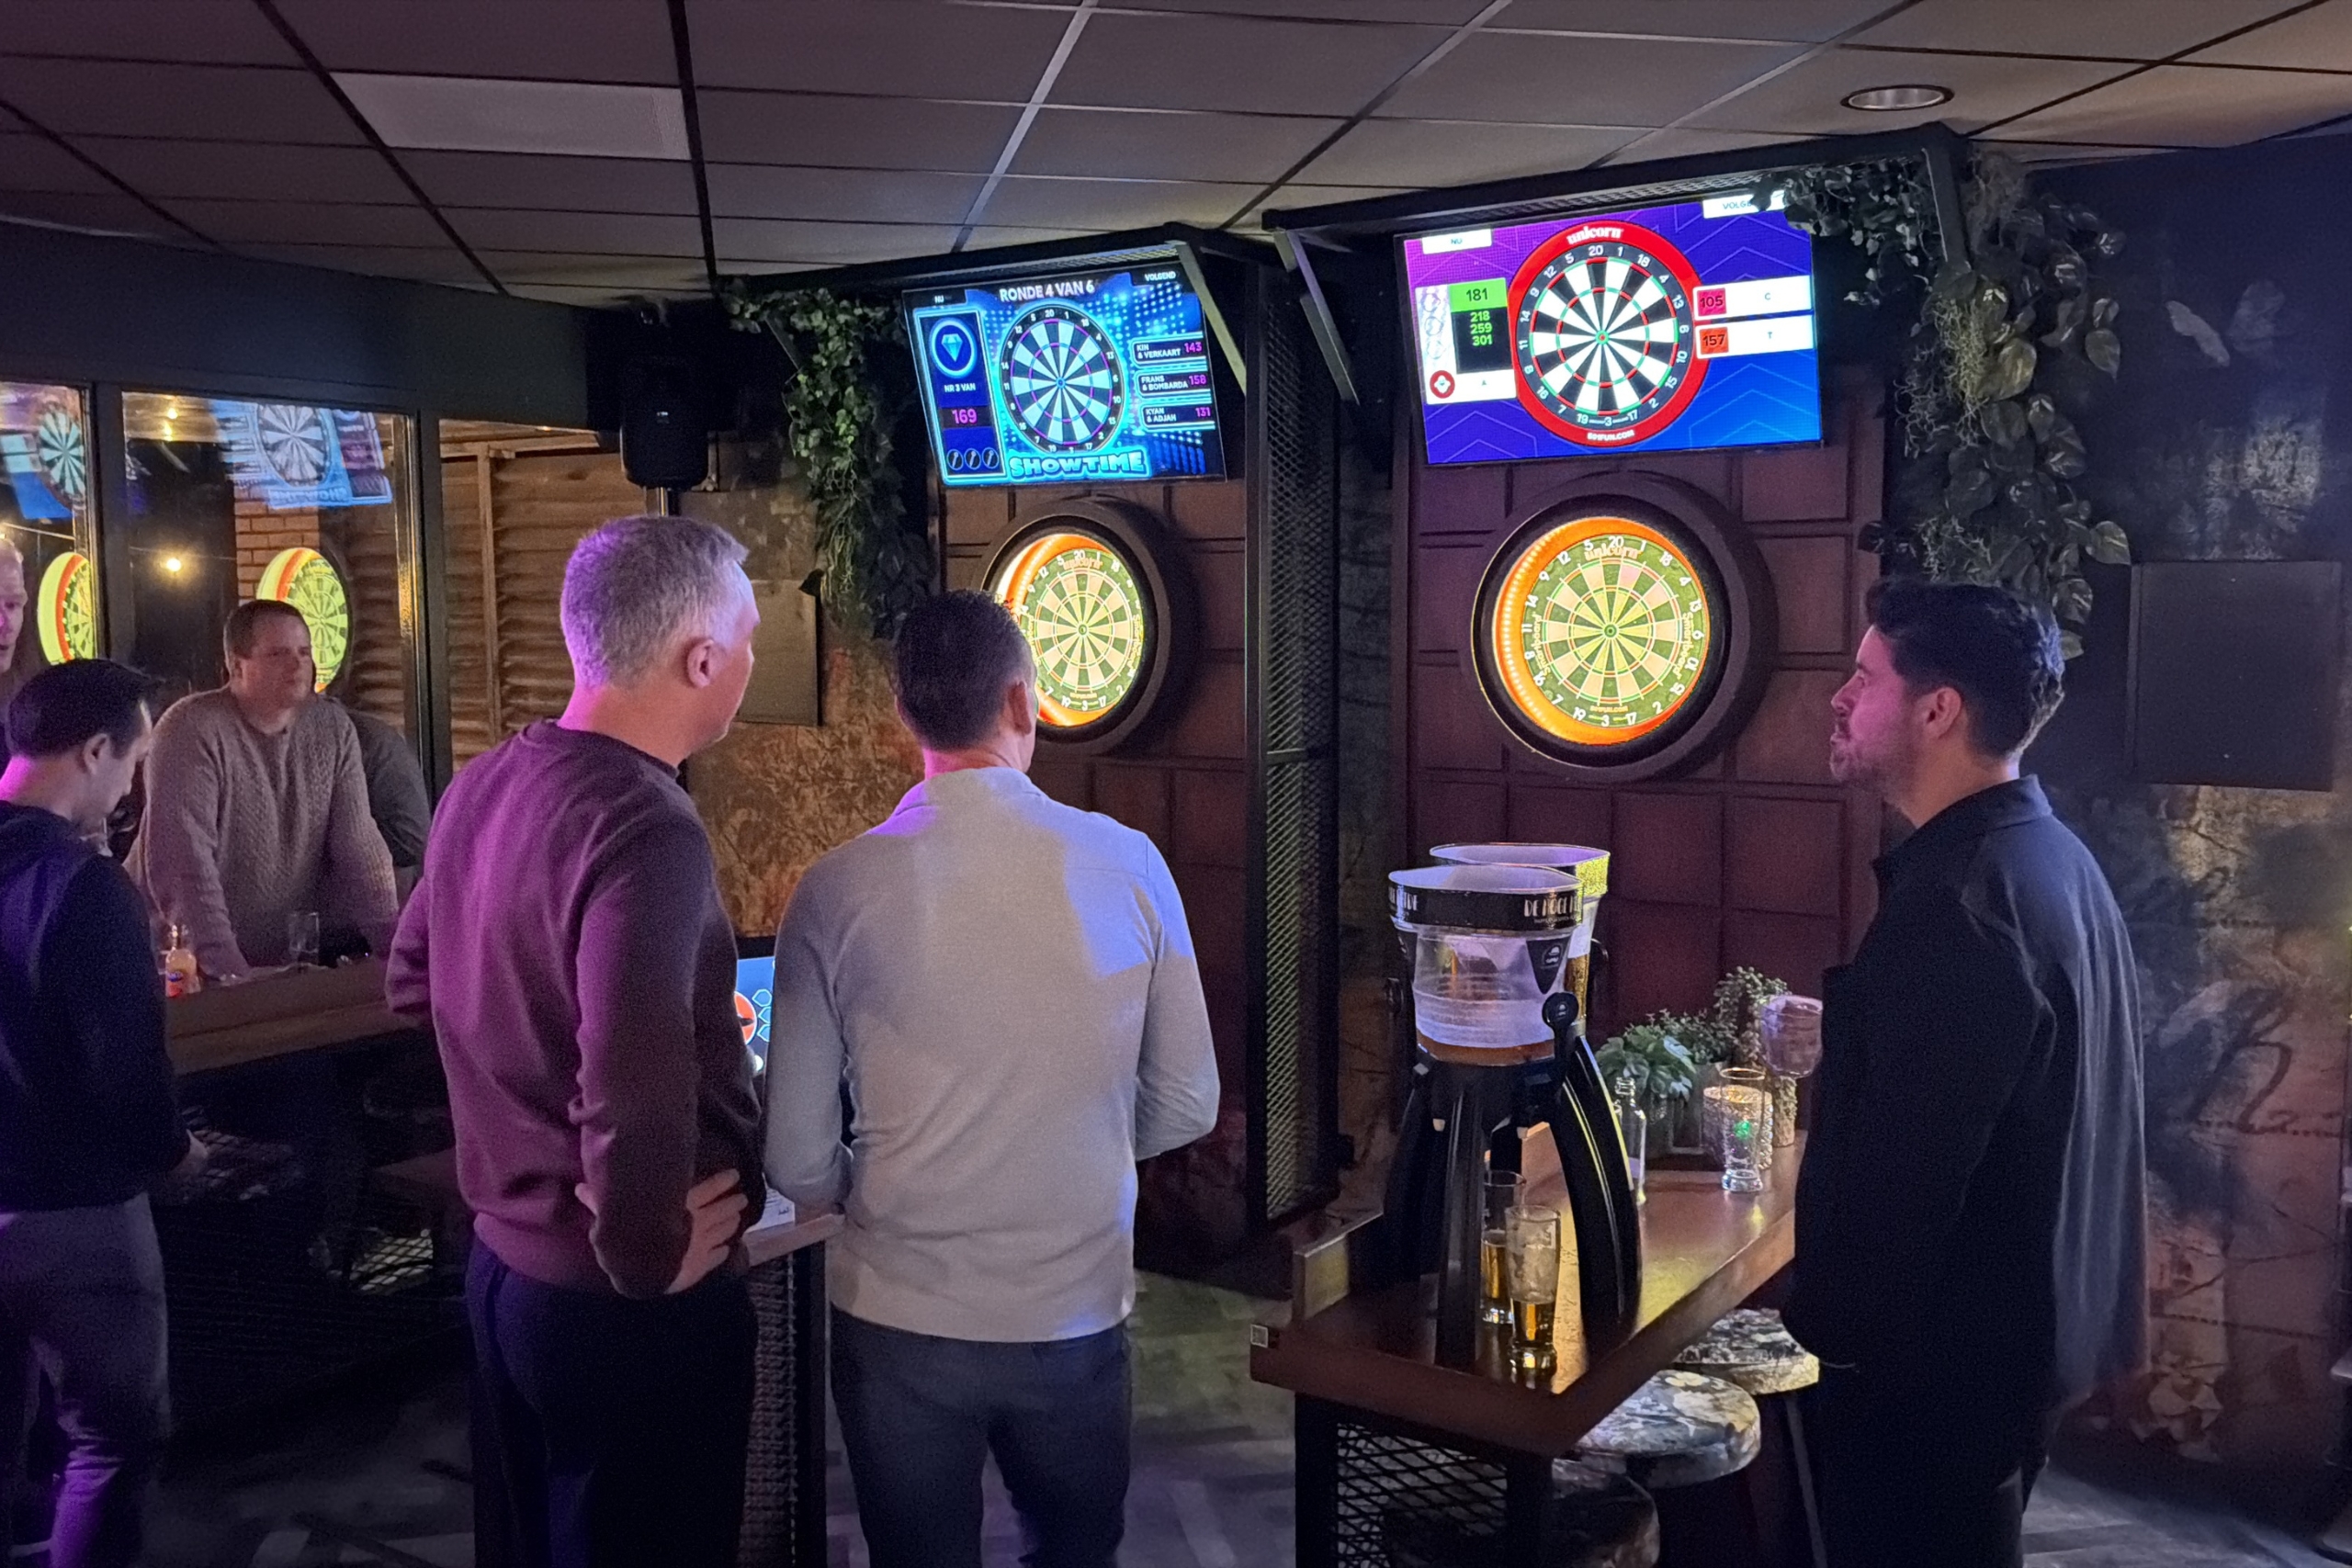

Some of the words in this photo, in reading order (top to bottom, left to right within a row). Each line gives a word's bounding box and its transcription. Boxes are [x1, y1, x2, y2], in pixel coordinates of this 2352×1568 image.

[1566, 226, 1624, 245] unicorn
[1589, 245, 1603, 256] 20
[1618, 246, 1624, 256] 1
[1565, 254, 1575, 265] 5
[1637, 254, 1650, 267] 18
[1145, 271, 1177, 281] VOLGEND
[1544, 265, 1556, 278] 12
[1659, 274, 1669, 283] 4
[999, 285, 1044, 302] RONDE
[1045, 284, 1054, 297] 4
[1055, 280, 1084, 296] VAN
[1085, 279, 1095, 293] 6
[1465, 288, 1488, 302] 181
[1530, 287, 1540, 298] 9
[934, 295, 944, 303] NU
[1673, 295, 1685, 309] 13
[1700, 296, 1724, 308] 105
[1764, 292, 1771, 300] C
[1045, 310, 1054, 318] 20
[1470, 310, 1490, 322] 218
[1520, 310, 1531, 323] 14
[1014, 325, 1023, 333] 12
[1470, 322, 1492, 334] 259
[1472, 334, 1493, 346] 301
[1519, 340, 1528, 350] 11
[1702, 333, 1725, 346] 157
[1144, 348, 1181, 359] VERKAART
[1184, 342, 1202, 353] 143
[1676, 351, 1688, 364] 10
[1524, 365, 1533, 374] 8
[1141, 375, 1165, 383] FRANS
[1148, 380, 1188, 390] BOMBARDA
[1189, 374, 1206, 385] 158
[1665, 376, 1678, 389] 15
[944, 384, 955, 392] NR
[956, 383, 960, 391] 3
[961, 382, 976, 391] VAN
[1537, 386, 1548, 400] 16
[1558, 404, 1567, 413] 7
[1649, 399, 1659, 408] 2
[951, 408, 978, 424] 169
[1195, 407, 1211, 417] 131
[1627, 409, 1638, 422] 17
[1577, 413, 1589, 424] 19
[1604, 417, 1612, 426] 3
[1099, 432, 1103, 440] 2
[1085, 442, 1092, 450] 17
[1009, 450, 1144, 478] SHOWTIME
[1583, 538, 1594, 550] 5
[1608, 536, 1624, 548] 20
[1640, 539, 1646, 551] 1
[1556, 551, 1571, 565] 12
[1584, 543, 1643, 561] unicorn
[1659, 551, 1673, 567] 18
[1539, 570, 1550, 581] 9
[1679, 575, 1691, 587] 4
[1521, 623, 1532, 633] 11
[1524, 650, 1535, 660] 8
[1685, 657, 1699, 671] 10
[1533, 672, 1545, 686] 16
[1669, 682, 1685, 695] 15
[1552, 694, 1564, 705] 7
[1573, 706, 1587, 721] 19
[1652, 701, 1663, 715] 2
[1600, 715, 1610, 728] 3
[1625, 712, 1637, 726] 17
